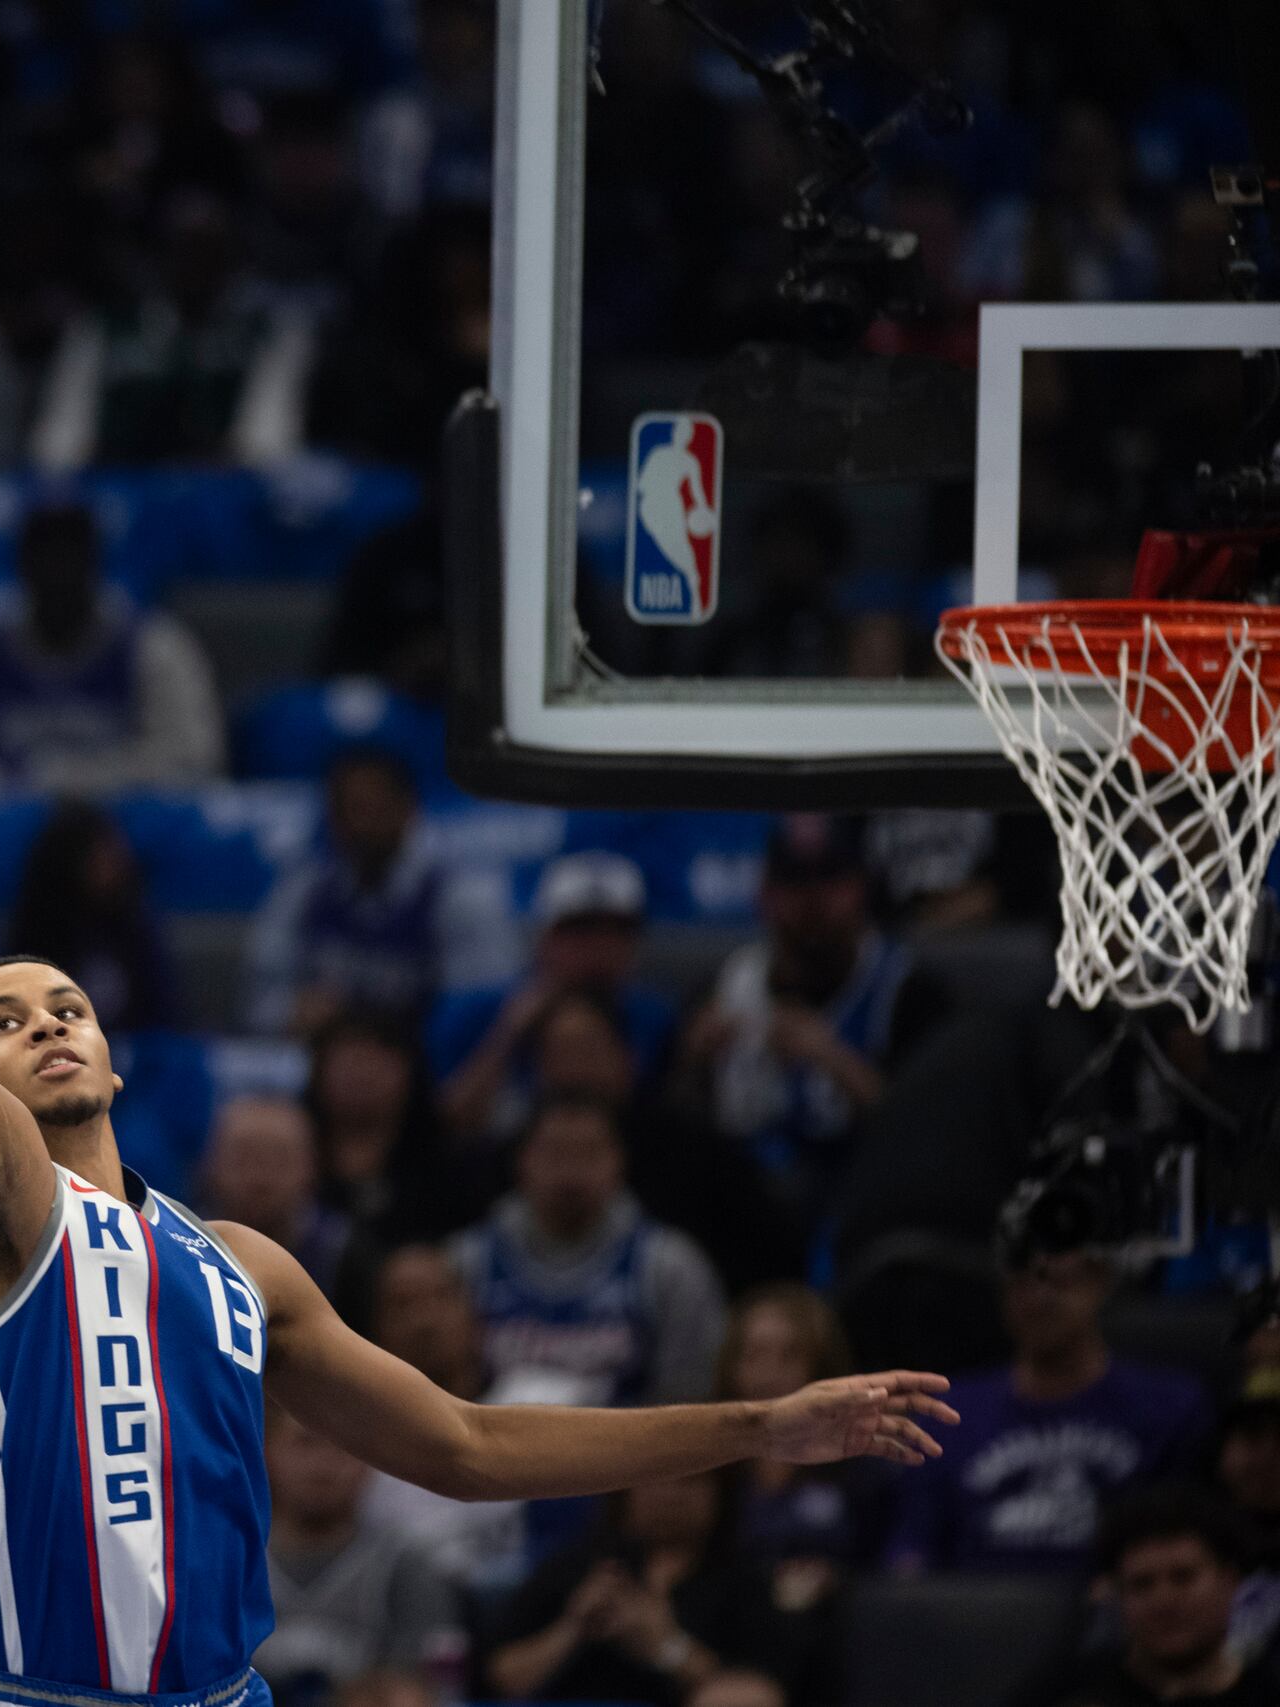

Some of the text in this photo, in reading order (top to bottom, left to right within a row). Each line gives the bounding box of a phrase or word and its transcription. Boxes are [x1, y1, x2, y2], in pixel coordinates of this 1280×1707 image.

[641, 573, 683, 609] NBA
[83, 1200, 152, 1525] KINGS
[199, 1261, 263, 1375] 13
